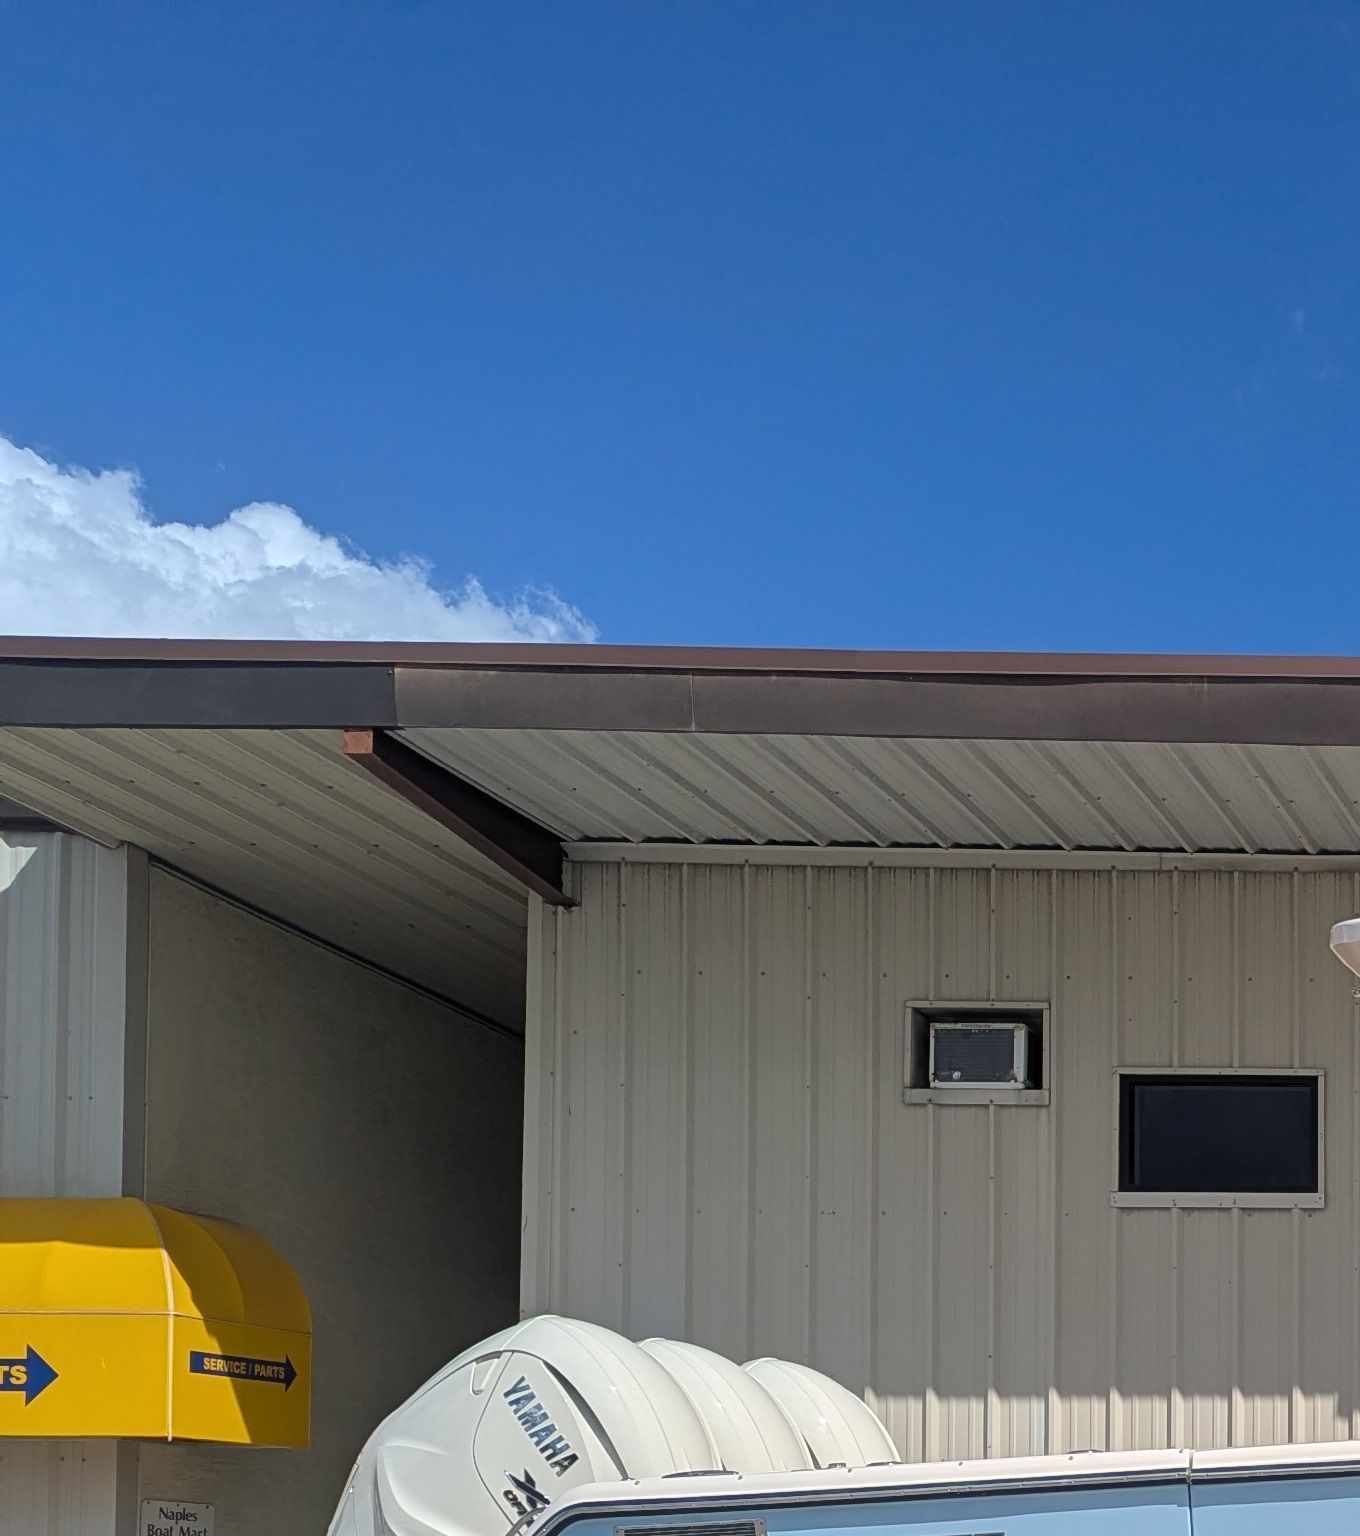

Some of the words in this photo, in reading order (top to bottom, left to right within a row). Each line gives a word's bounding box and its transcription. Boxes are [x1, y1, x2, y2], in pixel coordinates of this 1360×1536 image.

[203, 1357, 247, 1374] SERVICE
[254, 1363, 285, 1379] PARTS
[503, 1375, 580, 1478] YAMAHA
[159, 1506, 199, 1525] Naples
